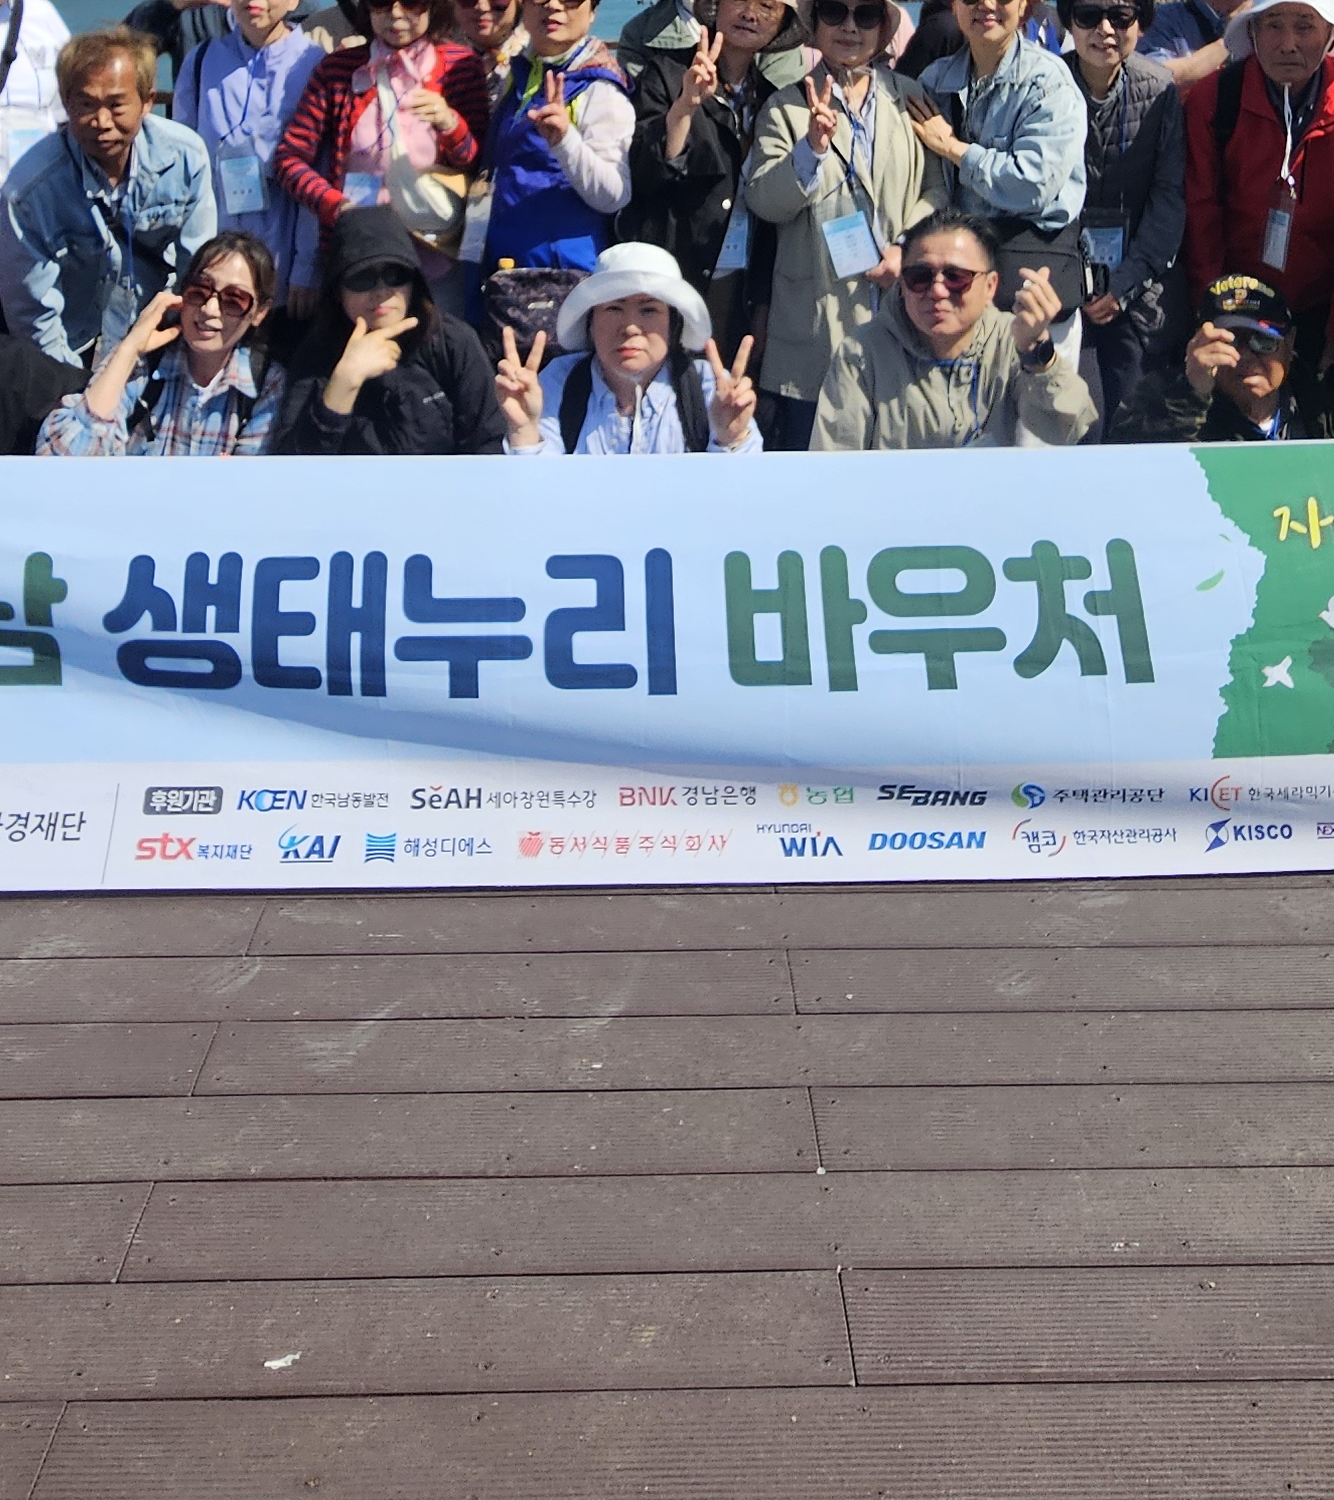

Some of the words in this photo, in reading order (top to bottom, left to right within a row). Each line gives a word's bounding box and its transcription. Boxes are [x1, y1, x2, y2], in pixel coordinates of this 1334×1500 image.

[102, 547, 679, 700] 생태누리
[724, 537, 1156, 693] 바우처
[149, 789, 218, 813] 후원기관
[311, 792, 389, 809] 한국남동발전
[486, 789, 598, 810] 세아창원특수강
[618, 786, 678, 807] BNK
[681, 784, 758, 807] 경남은행
[806, 785, 855, 805] 농협
[877, 784, 988, 807] SEBANG
[1052, 787, 1165, 804] 주택관리공단
[756, 822, 812, 834] HYUNDAI
[1072, 827, 1178, 846] 한국자산관리공사
[1233, 822, 1293, 842] KISCO
[279, 833, 342, 861] KAI
[403, 836, 493, 858] 해성디에스
[549, 832, 728, 858] 동서식품주식회사
[779, 834, 844, 858] WIA
[868, 830, 987, 851] DOOSAN
[197, 844, 253, 860] 복지재단
